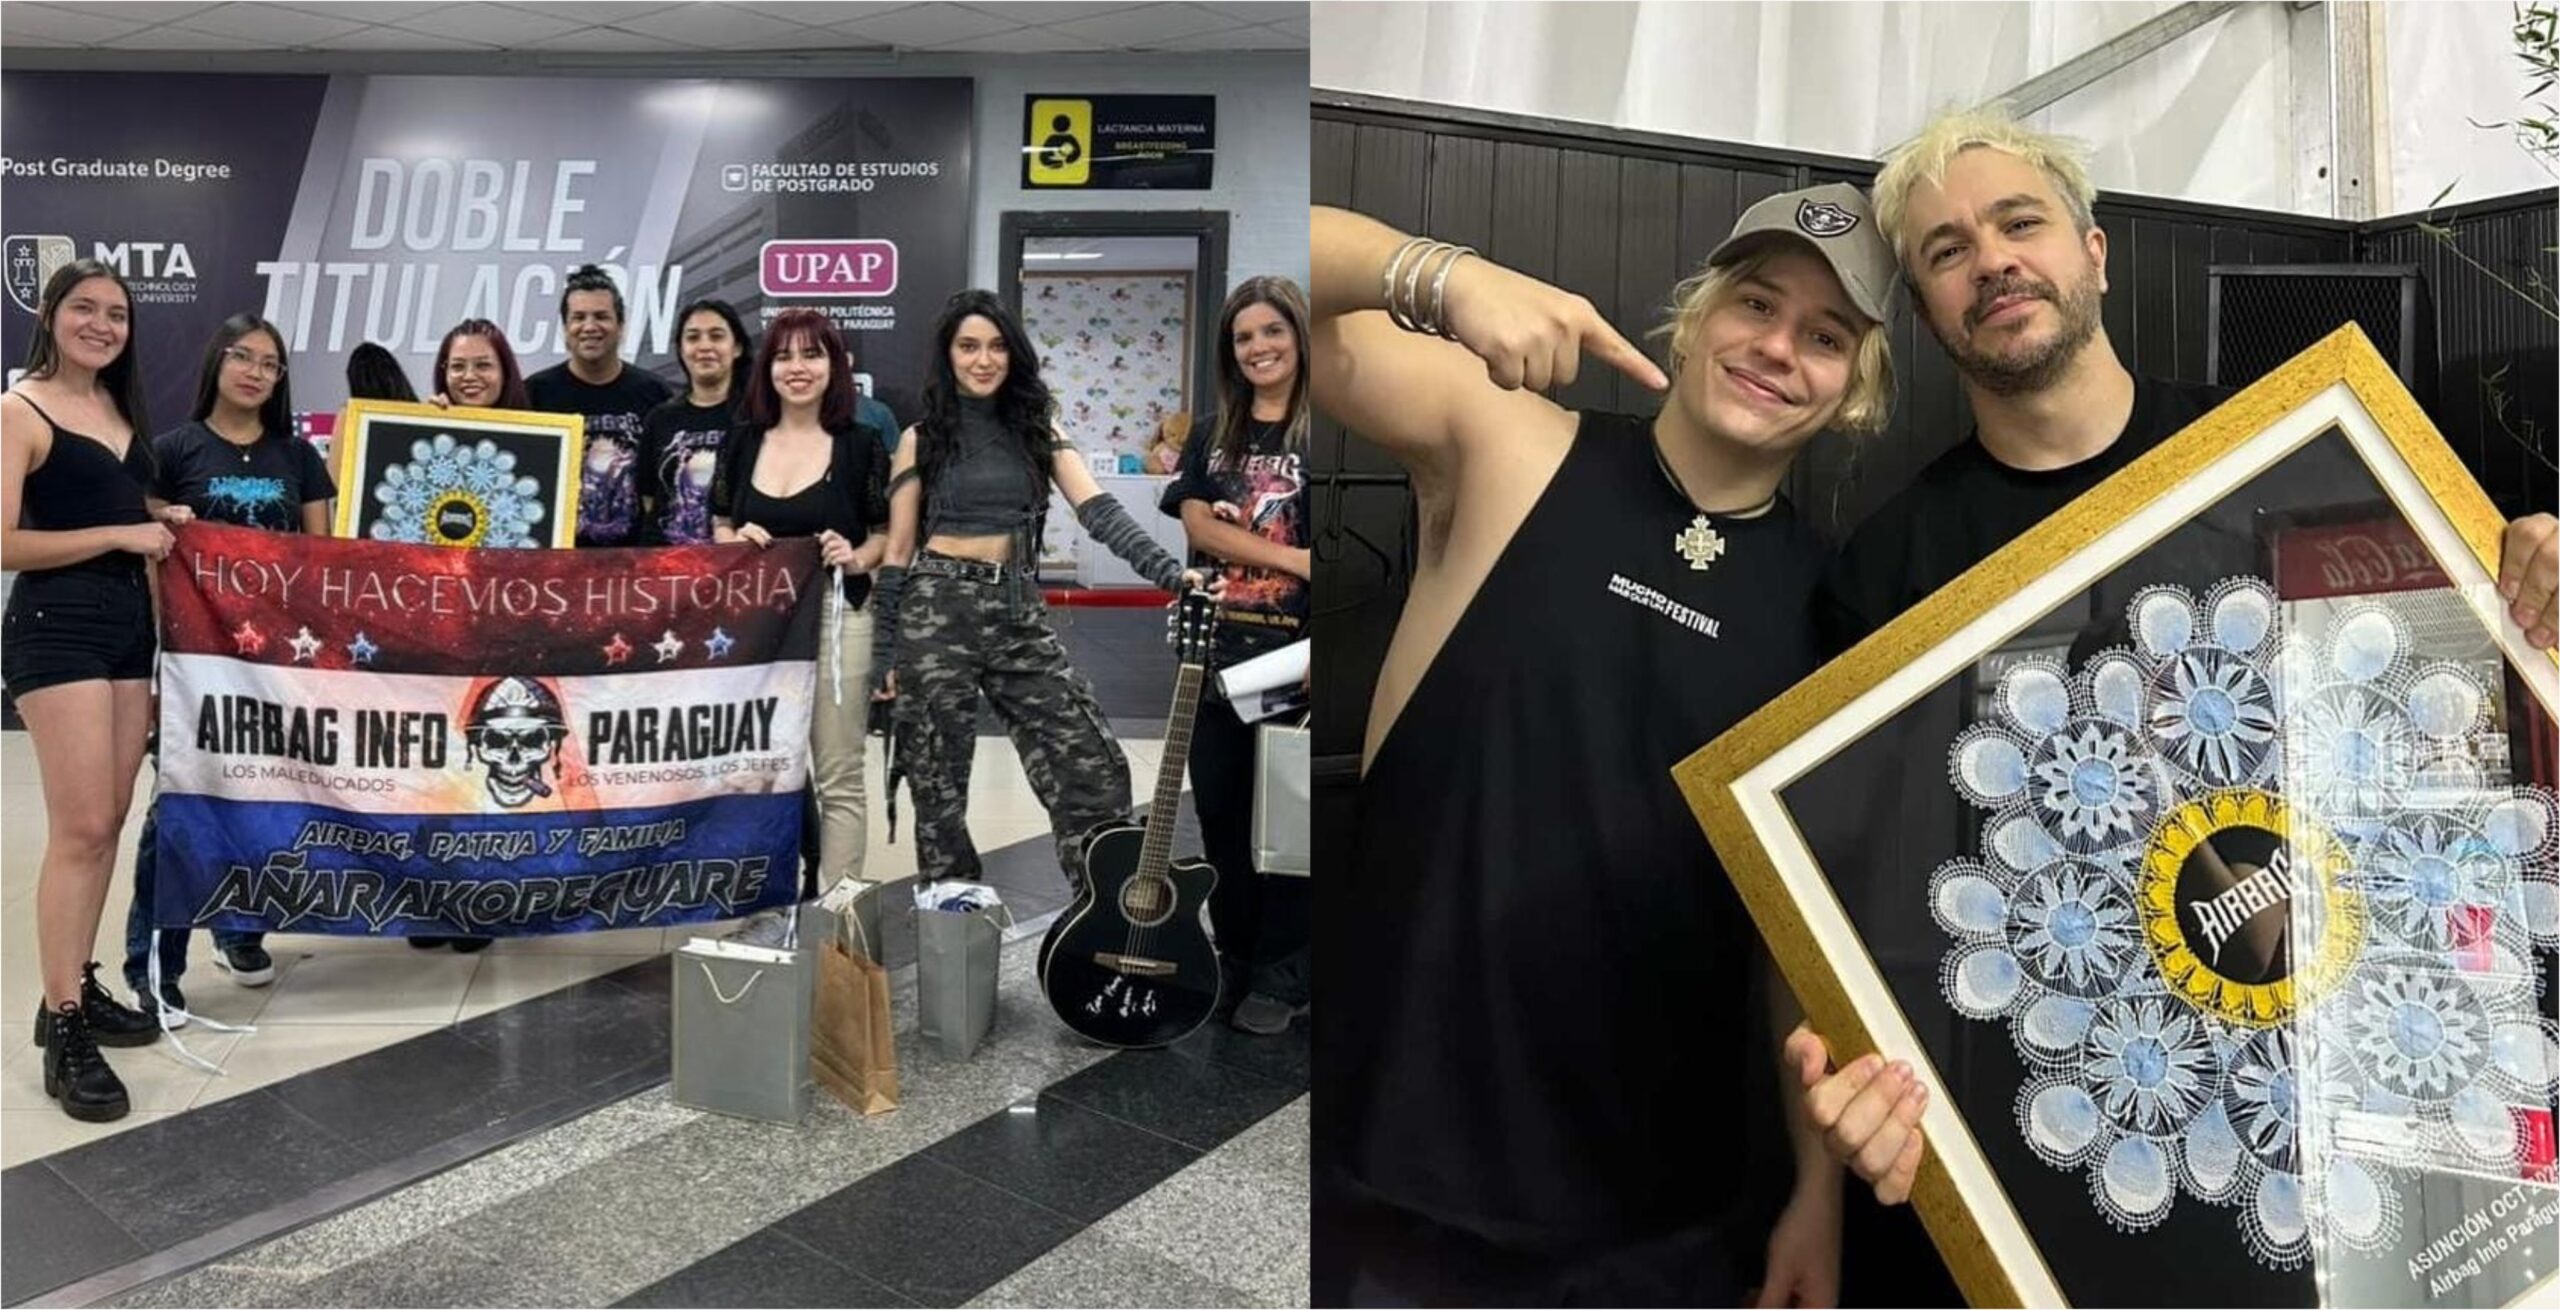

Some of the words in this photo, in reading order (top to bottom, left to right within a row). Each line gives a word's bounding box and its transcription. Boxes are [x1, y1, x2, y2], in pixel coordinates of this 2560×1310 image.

[1097, 123, 1155, 134] LACTANCIA
[1156, 123, 1206, 134] MATERNA
[1, 157, 46, 176] Post
[51, 157, 149, 177] Graduate
[154, 158, 231, 182] Degree
[751, 179, 776, 193] DE
[777, 178, 875, 193] POSTGRADO
[752, 163, 831, 178] FACULTAD
[835, 163, 857, 177] DE
[861, 162, 940, 177] ESTUDIOS
[350, 157, 597, 252] DOBLE
[94, 241, 197, 279] MTA
[775, 252, 883, 284] UPAP
[127, 280, 197, 293] ECHNOLOGY
[137, 292, 198, 304] UNIVERSITY
[829, 303, 896, 318] POLITÉCNICA
[842, 318, 896, 330] PARAGUAY
[194, 551, 303, 602] HOY
[321, 566, 569, 617] HACEMOS
[1610, 573, 1668, 605] MUCHO
[1663, 599, 1721, 639] FESTIVAL
[196, 693, 339, 766] AIRBAG
[354, 709, 448, 770] INFO
[587, 697, 779, 766] PARAGUAY
[222, 763, 256, 780] LOS
[259, 765, 396, 792] MALEDUCADOS
[568, 773, 599, 788] LOS
[711, 760, 738, 777] LOS
[742, 756, 791, 773] JEFES
[428, 830, 537, 862] PATRIA
[545, 828, 573, 854] Y
[577, 818, 686, 857] FAMILIA
[192, 849, 771, 933] AÑARAKOPEGUARE
[2189, 846, 2308, 967] AIRBAG
[2407, 1207, 2494, 1282] ASUNCIÓN
[2490, 1185, 2527, 1219] OCT
[2429, 1255, 2482, 1299] Airbag
[2475, 1236, 2509, 1265] Info
[2505, 1198, 2559, 1244] Paragu
